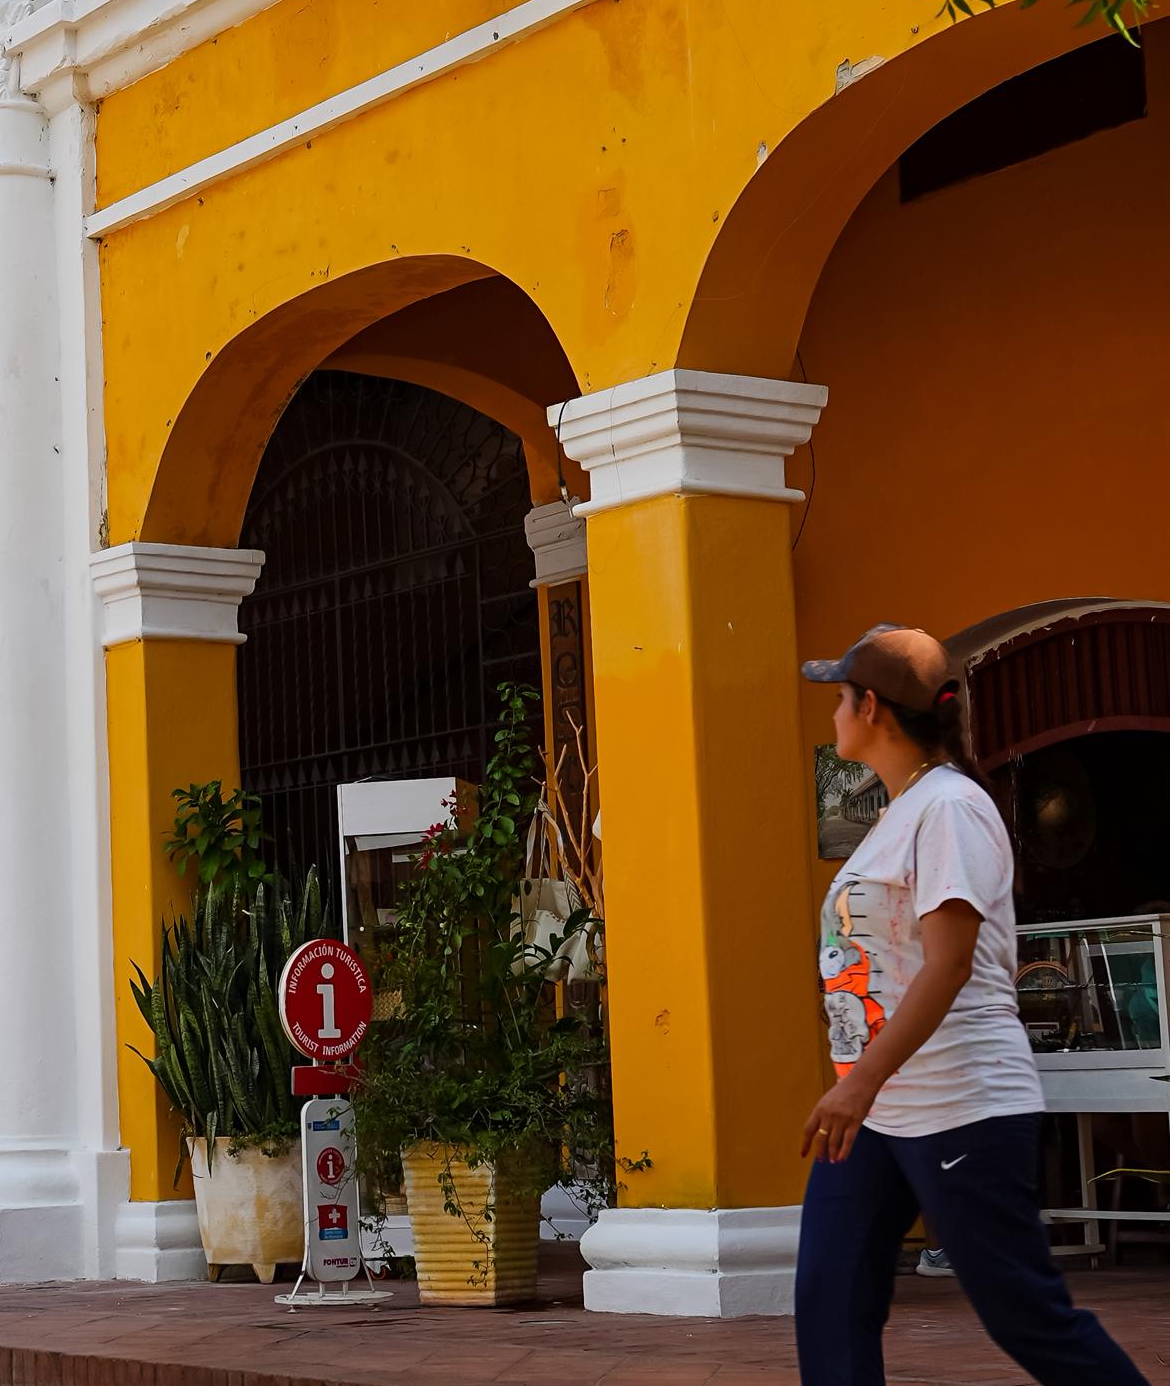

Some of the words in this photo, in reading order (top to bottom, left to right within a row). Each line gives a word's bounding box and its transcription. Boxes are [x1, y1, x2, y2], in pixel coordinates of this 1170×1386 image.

[289, 944, 334, 993] INFORMACIÓN
[292, 1021, 320, 1053] TOURIST
[322, 1020, 367, 1056] INFORMATION
[323, 1258, 348, 1266] FONTUR
